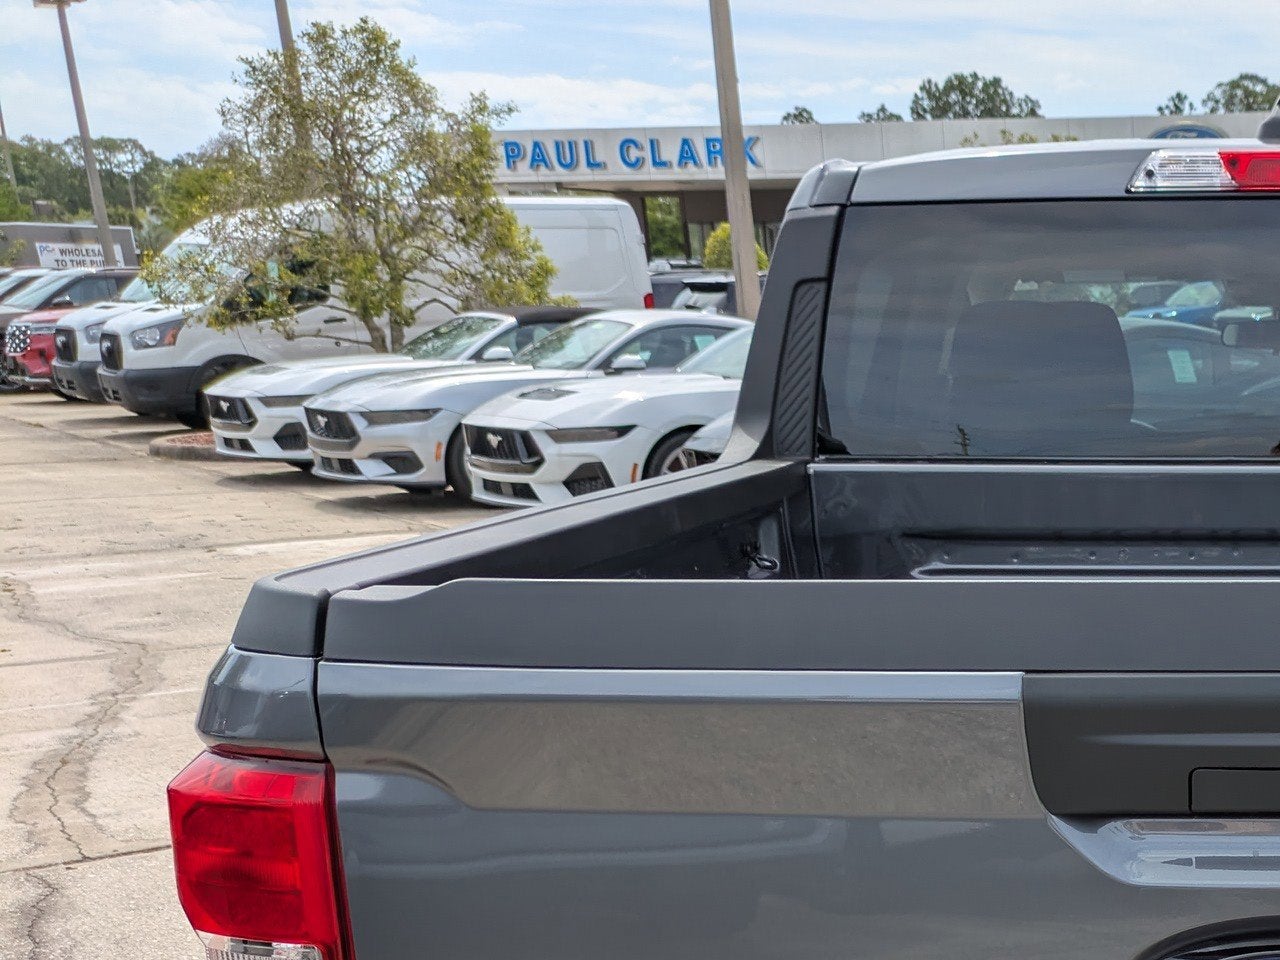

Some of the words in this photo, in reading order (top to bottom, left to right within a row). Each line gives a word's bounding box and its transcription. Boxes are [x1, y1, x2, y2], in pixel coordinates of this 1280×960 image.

[503, 138, 606, 171] PAUL
[619, 136, 762, 170] CLARK
[54, 259, 68, 267] TO
[69, 259, 87, 268] THE
